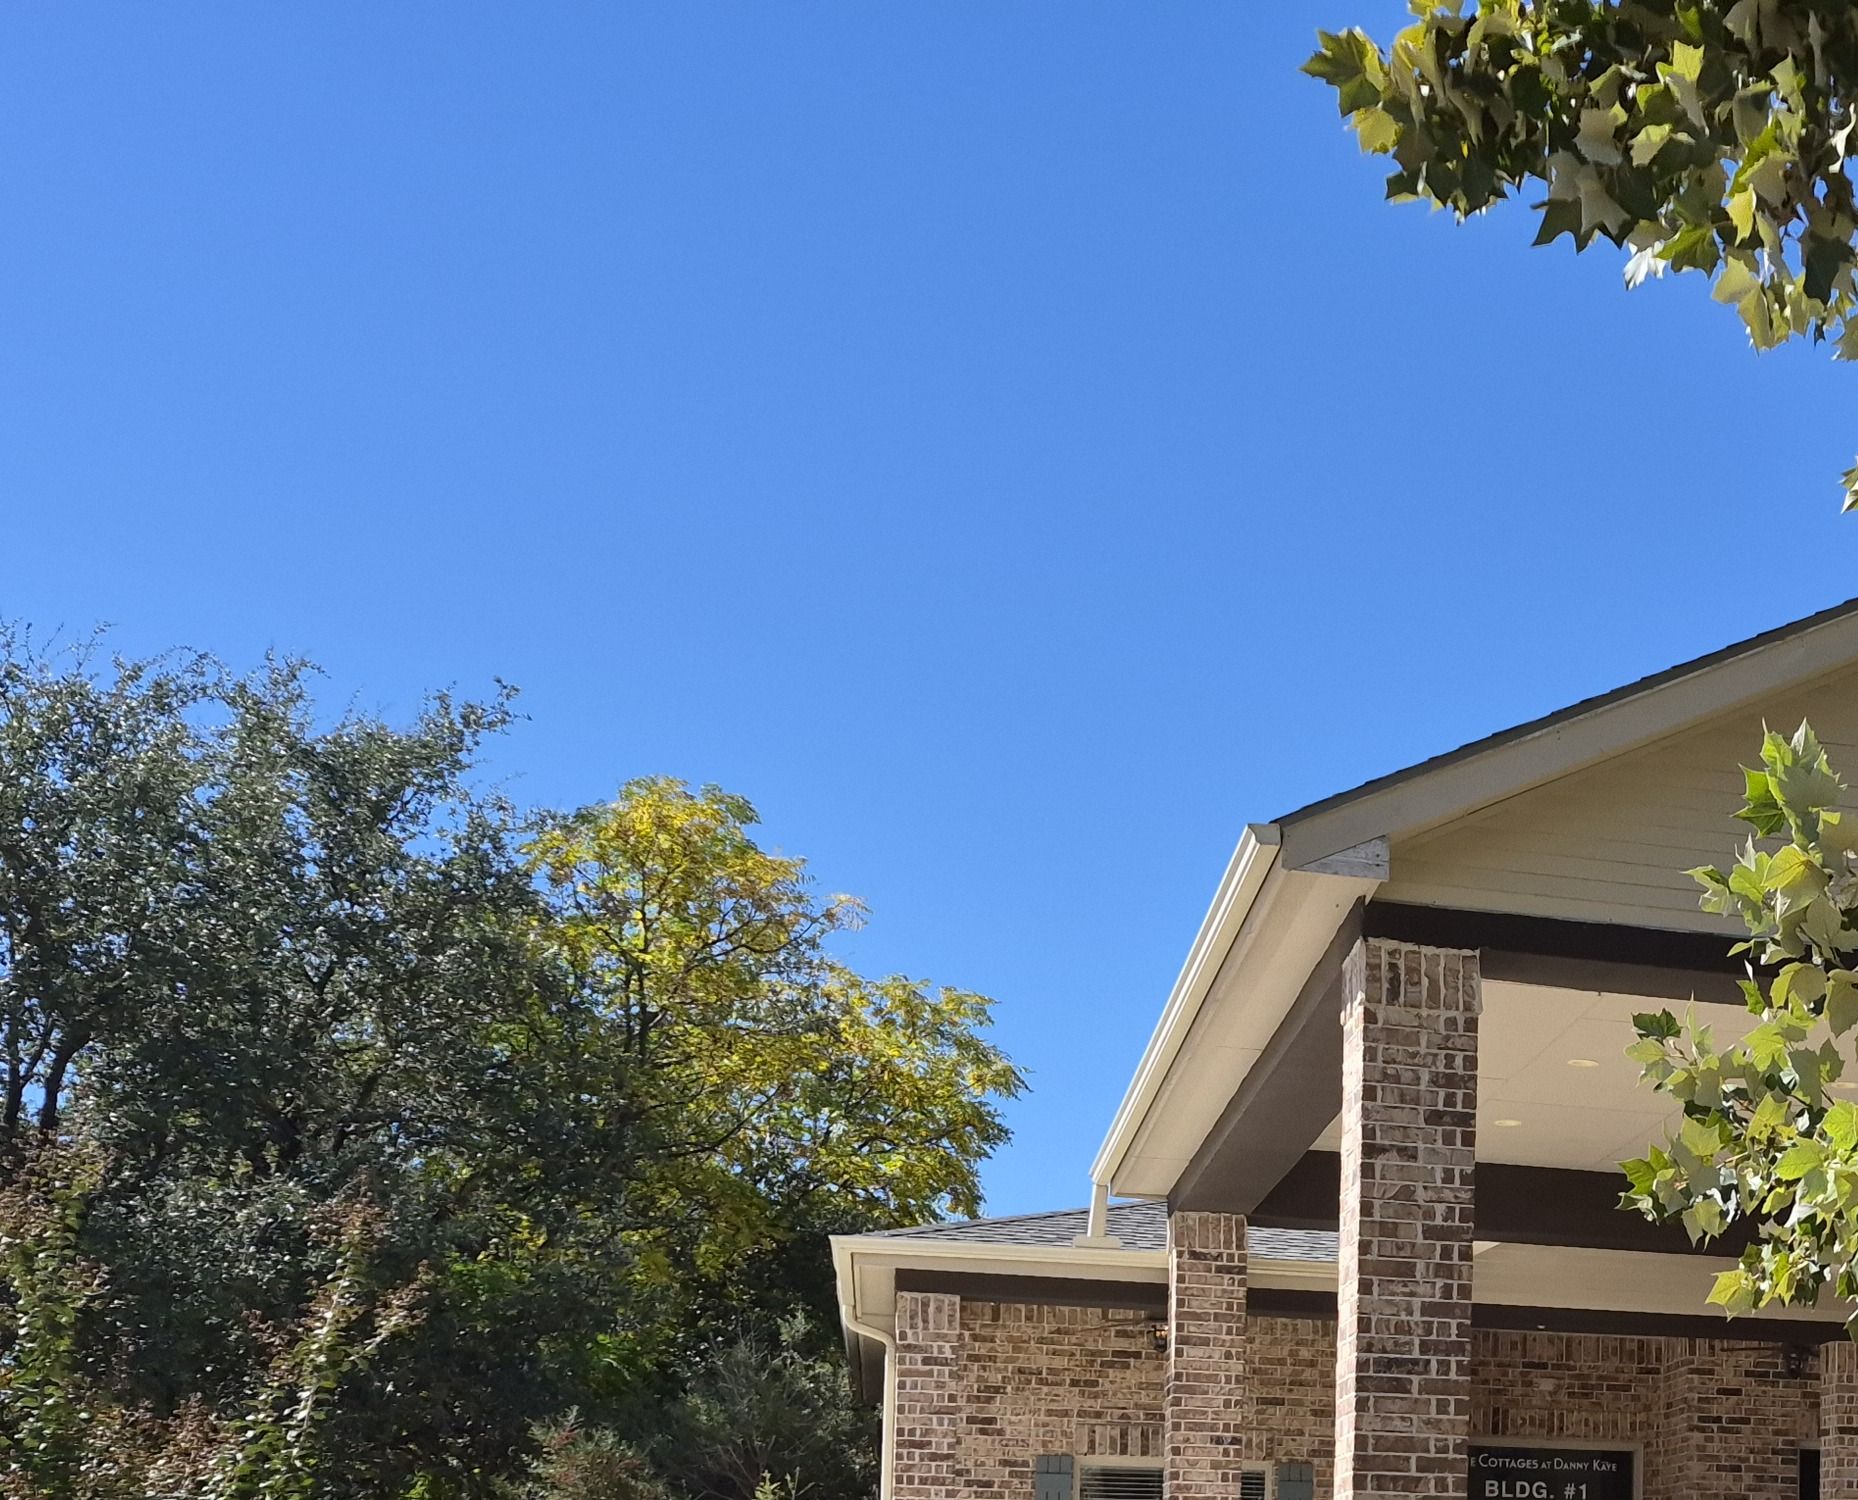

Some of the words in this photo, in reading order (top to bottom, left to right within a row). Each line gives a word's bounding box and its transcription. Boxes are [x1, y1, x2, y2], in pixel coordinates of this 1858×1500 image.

[1554, 1457, 1590, 1472] DANNY
[1485, 1479, 1555, 1499] BLDG.
[1563, 1483, 1588, 1500] #1
